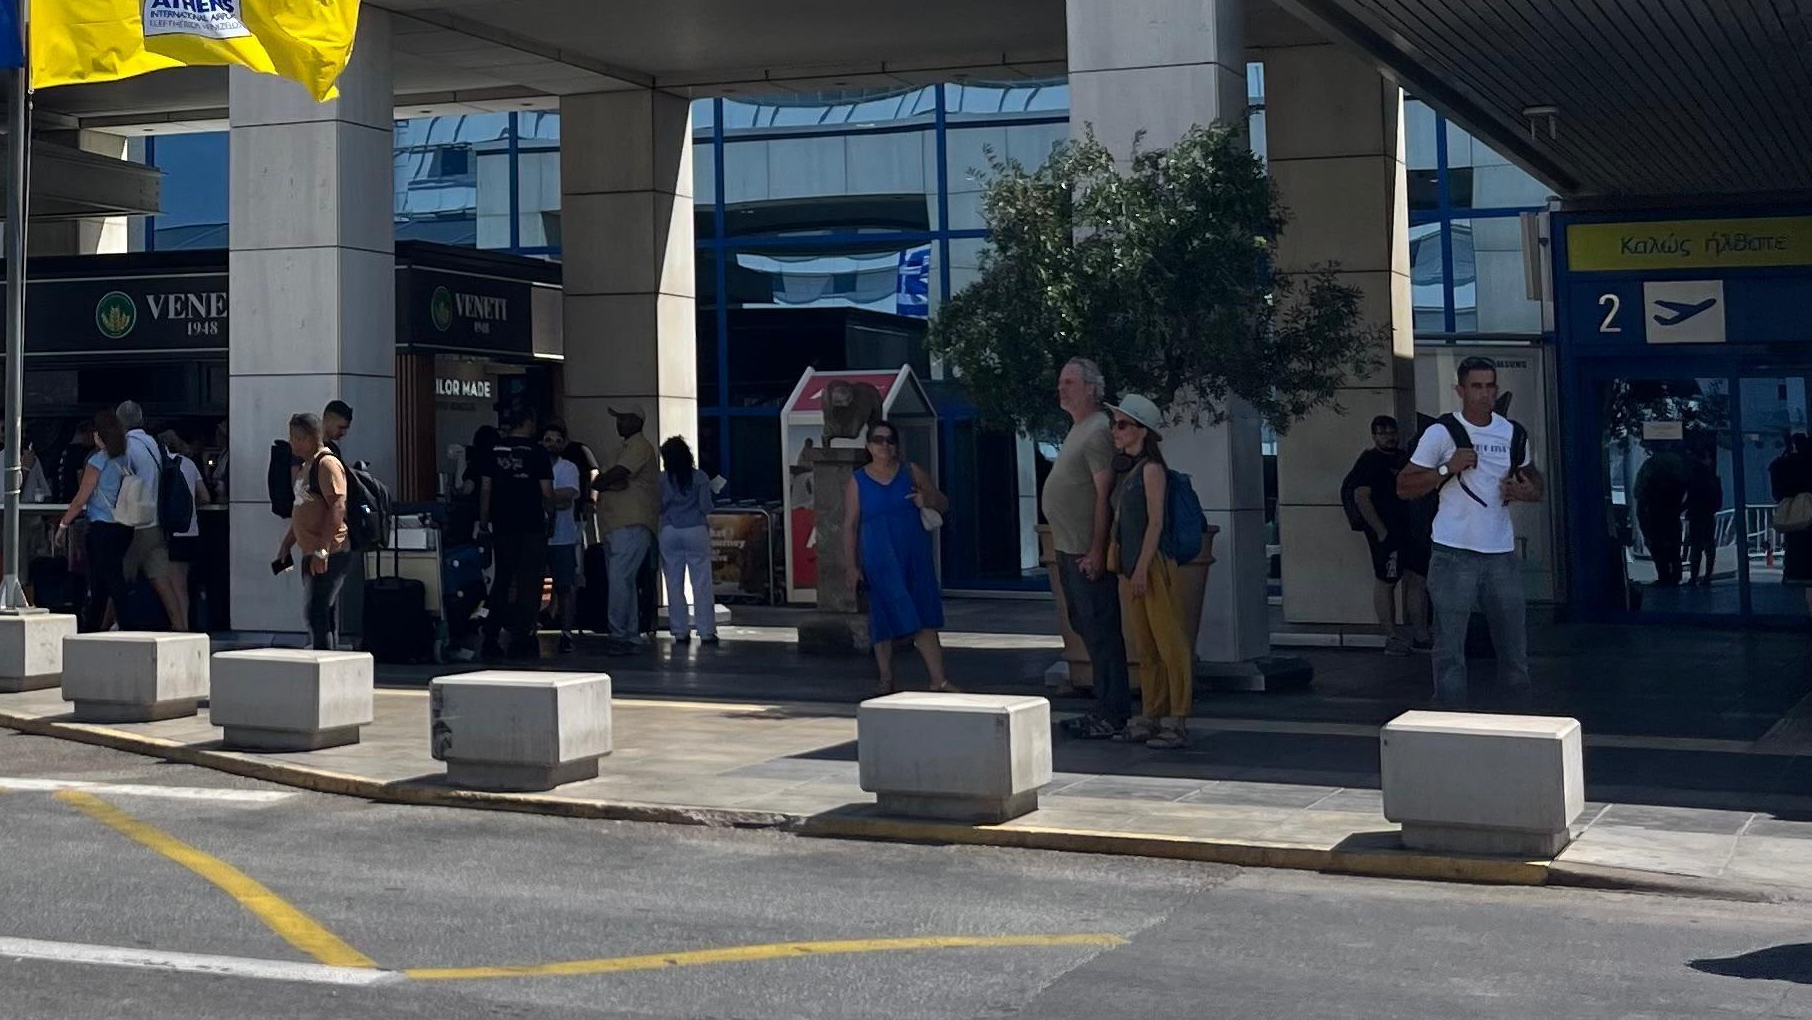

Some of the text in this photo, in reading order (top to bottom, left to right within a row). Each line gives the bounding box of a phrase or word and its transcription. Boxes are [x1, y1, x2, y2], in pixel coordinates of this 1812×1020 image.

[1620, 233, 1691, 256] Καλώς
[146, 292, 228, 320] VENE
[455, 293, 508, 321] VENETI
[1598, 293, 1621, 332] 2
[187, 321, 218, 335] 1948
[435, 378, 491, 398] ILOR MADE
